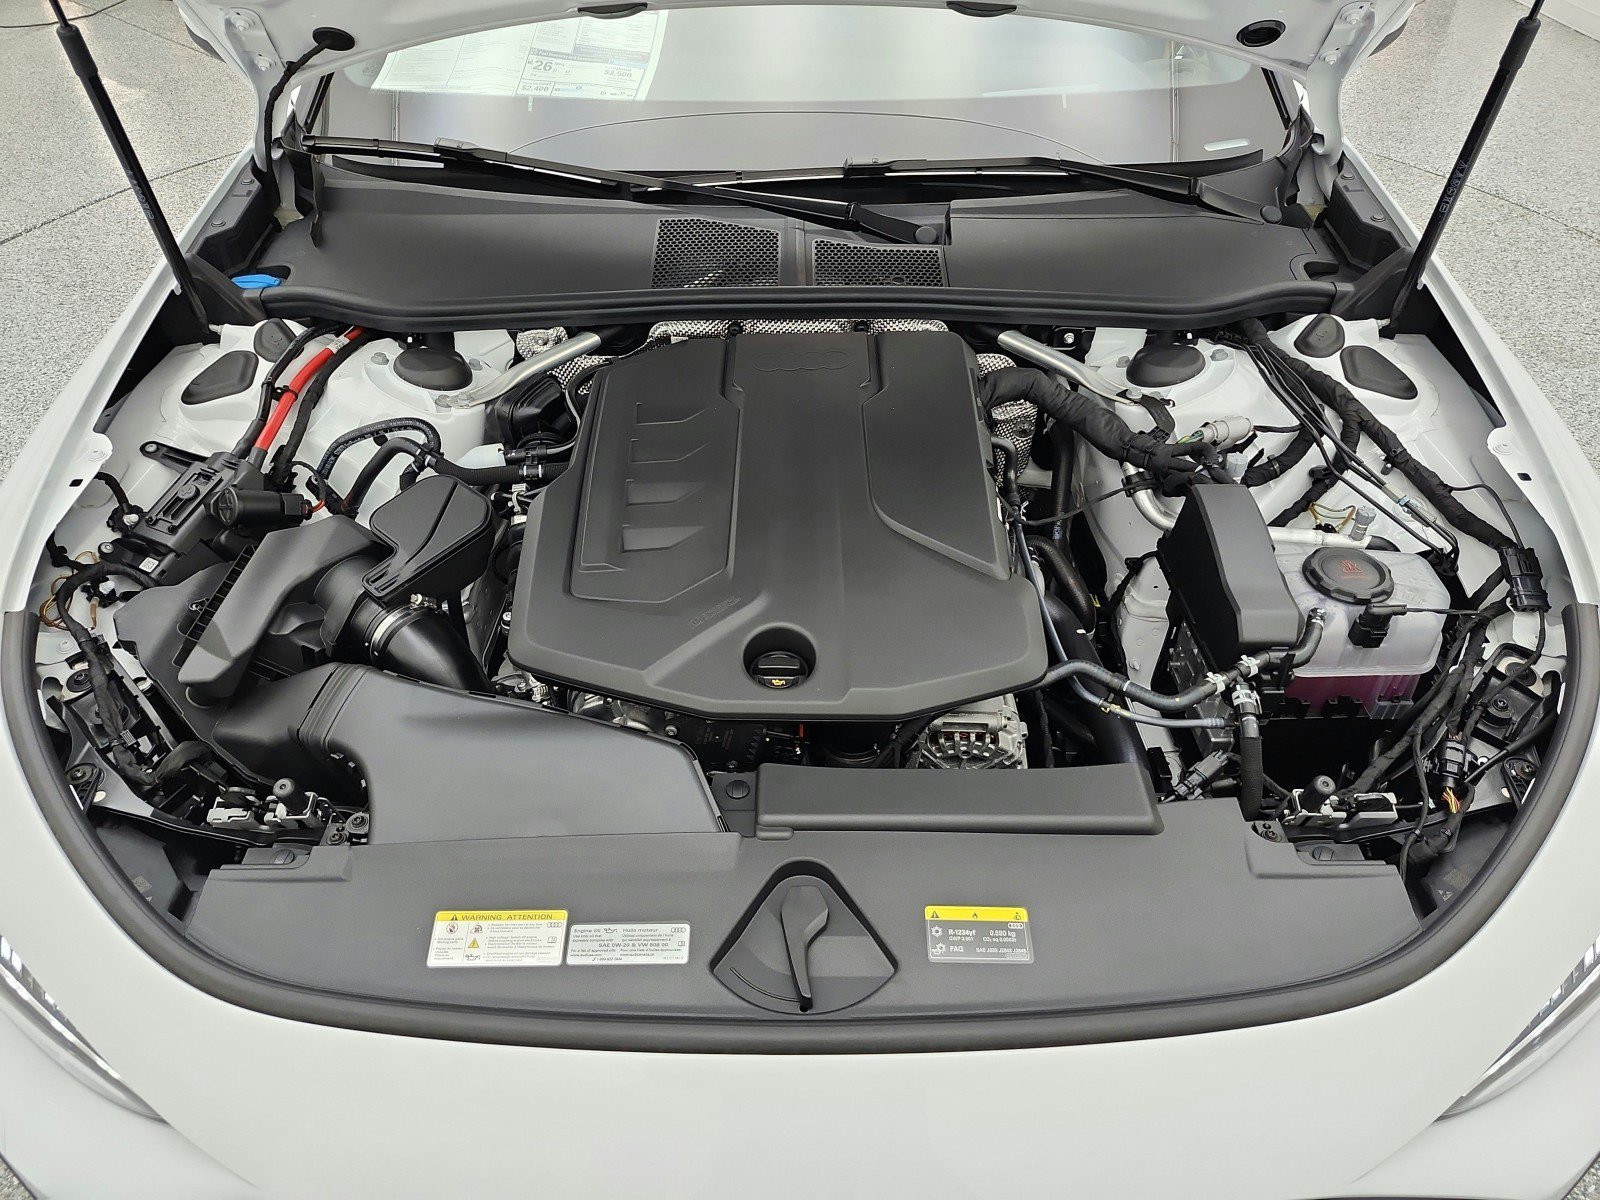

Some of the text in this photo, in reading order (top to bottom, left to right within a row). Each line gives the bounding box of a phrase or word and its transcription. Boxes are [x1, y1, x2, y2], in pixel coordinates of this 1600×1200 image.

[532, 60, 554, 72] 26
[603, 69, 633, 78] $3,500
[521, 84, 550, 92] $2,400
[948, 928, 976, 936] R-1234yf
[1007, 929, 1016, 937] kg
